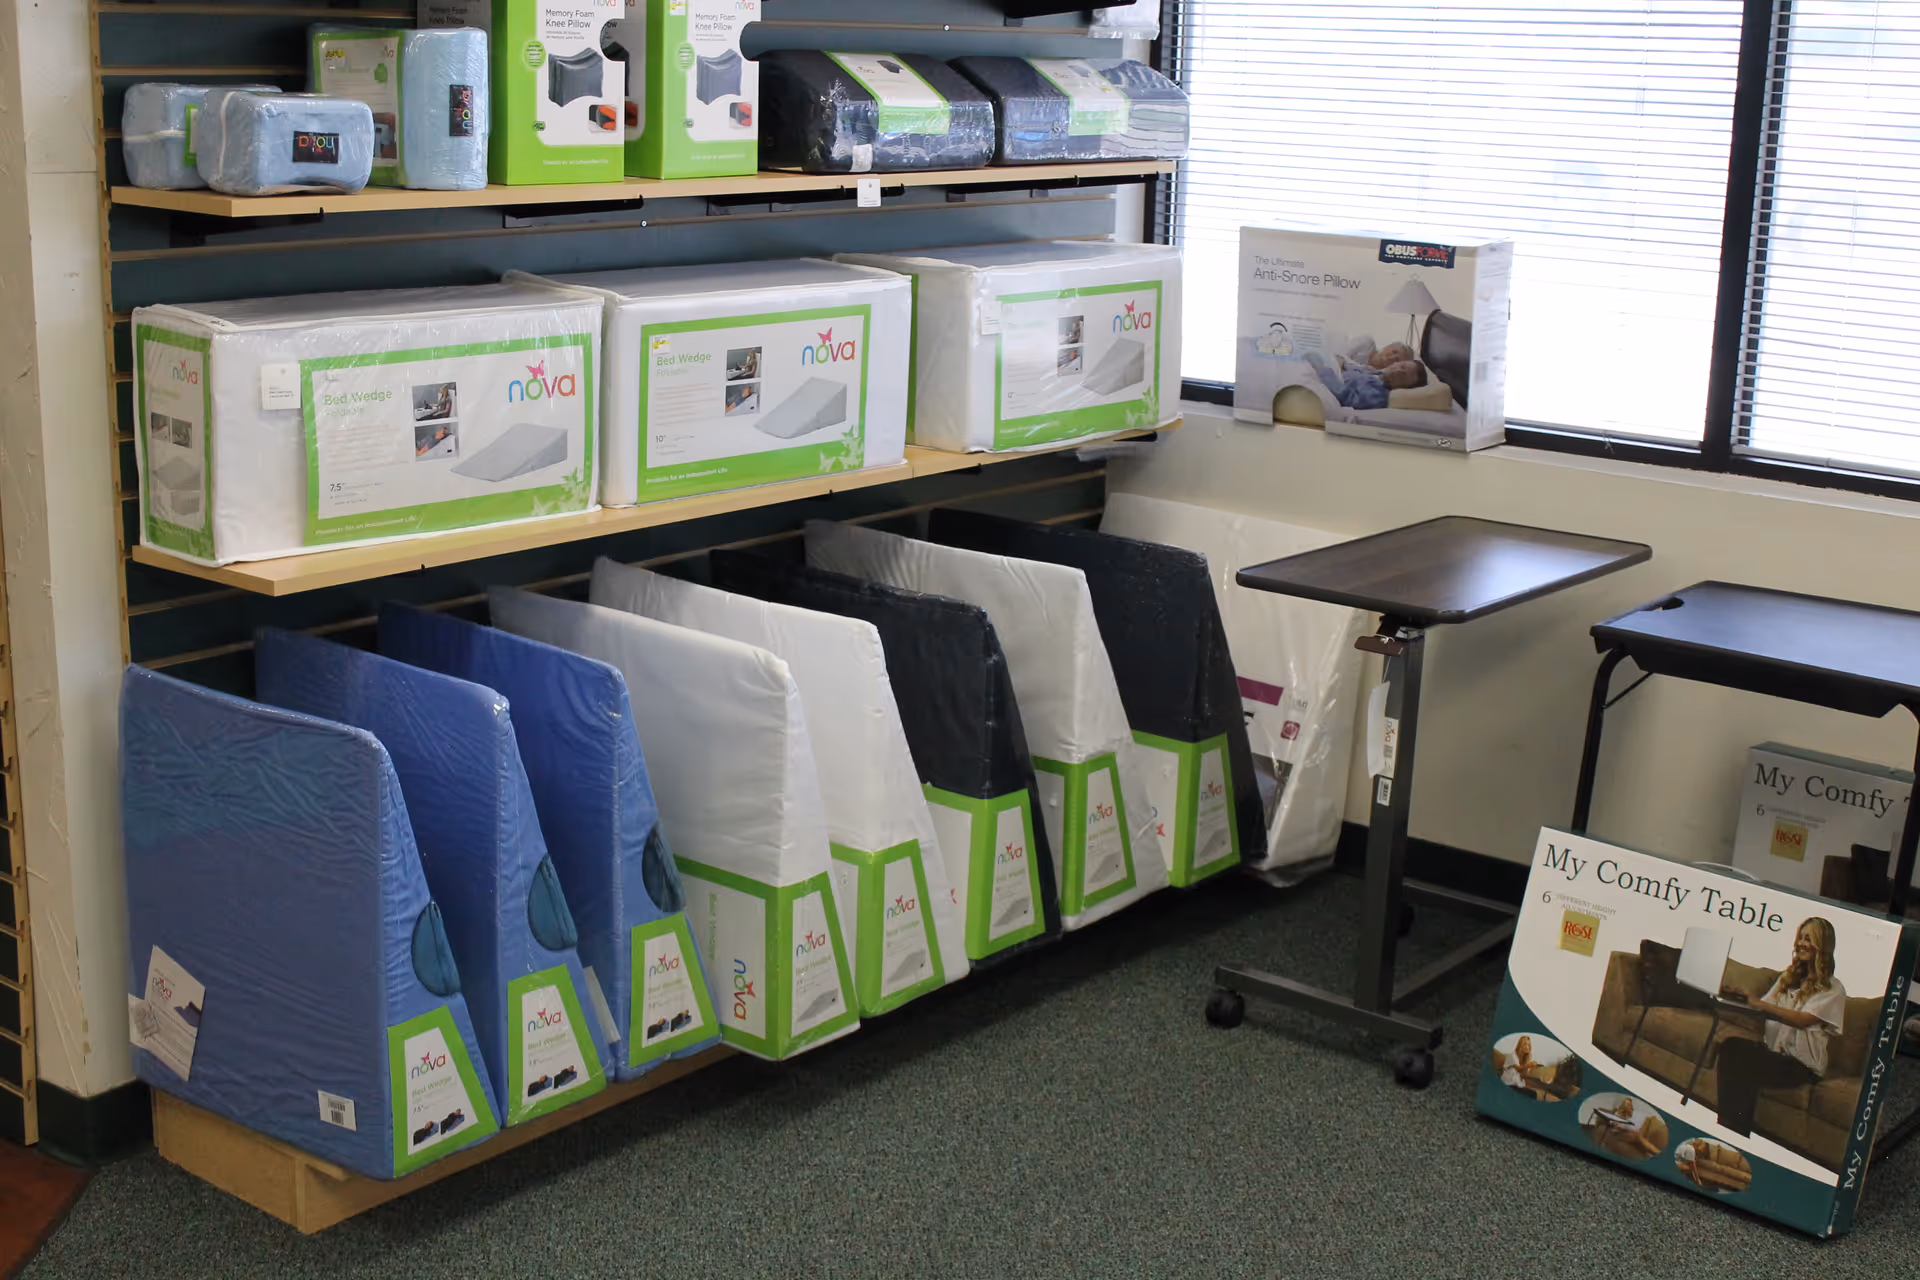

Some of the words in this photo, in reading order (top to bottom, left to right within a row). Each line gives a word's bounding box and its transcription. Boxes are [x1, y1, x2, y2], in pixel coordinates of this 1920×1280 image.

[545, 9, 574, 18] Memory
[575, 10, 595, 18] Foam
[545, 19, 566, 28] Knee
[567, 20, 592, 28] Pillow
[695, 13, 718, 21] Memory
[695, 23, 712, 31] Knee
[713, 23, 732, 31] Pillow
[1254, 255, 1270, 265] The
[1253, 267, 1320, 285] Anti-Snore
[1323, 274, 1361, 289] Pillow
[1113, 312, 1151, 332] nova
[656, 354, 675, 366] Bed
[678, 352, 712, 363] Wedge
[802, 340, 856, 365] nova
[172, 366, 199, 385] nova
[324, 392, 347, 405] Bed
[351, 389, 393, 402] Wedge
[509, 373, 575, 402] nova
[1754, 763, 1796, 796] My
[1805, 775, 1894, 819] Comfy
[1088, 805, 1113, 825] nova
[1756, 804, 1765, 816] 6
[997, 847, 1023, 865] nova
[1542, 843, 1588, 881] My
[1596, 860, 1691, 910] Comfy
[1700, 885, 1784, 932] Table
[1542, 890, 1553, 904] 6
[886, 898, 915, 919] nova
[796, 933, 826, 956] nova
[649, 956, 680, 977] nova
[734, 958, 747, 1021] nova
[528, 1011, 562, 1032] nova
[411, 1054, 446, 1080] nova
[1844, 1150, 1862, 1190] My
[1857, 1056, 1886, 1142] Comfy
[1879, 975, 1905, 1049] Table
